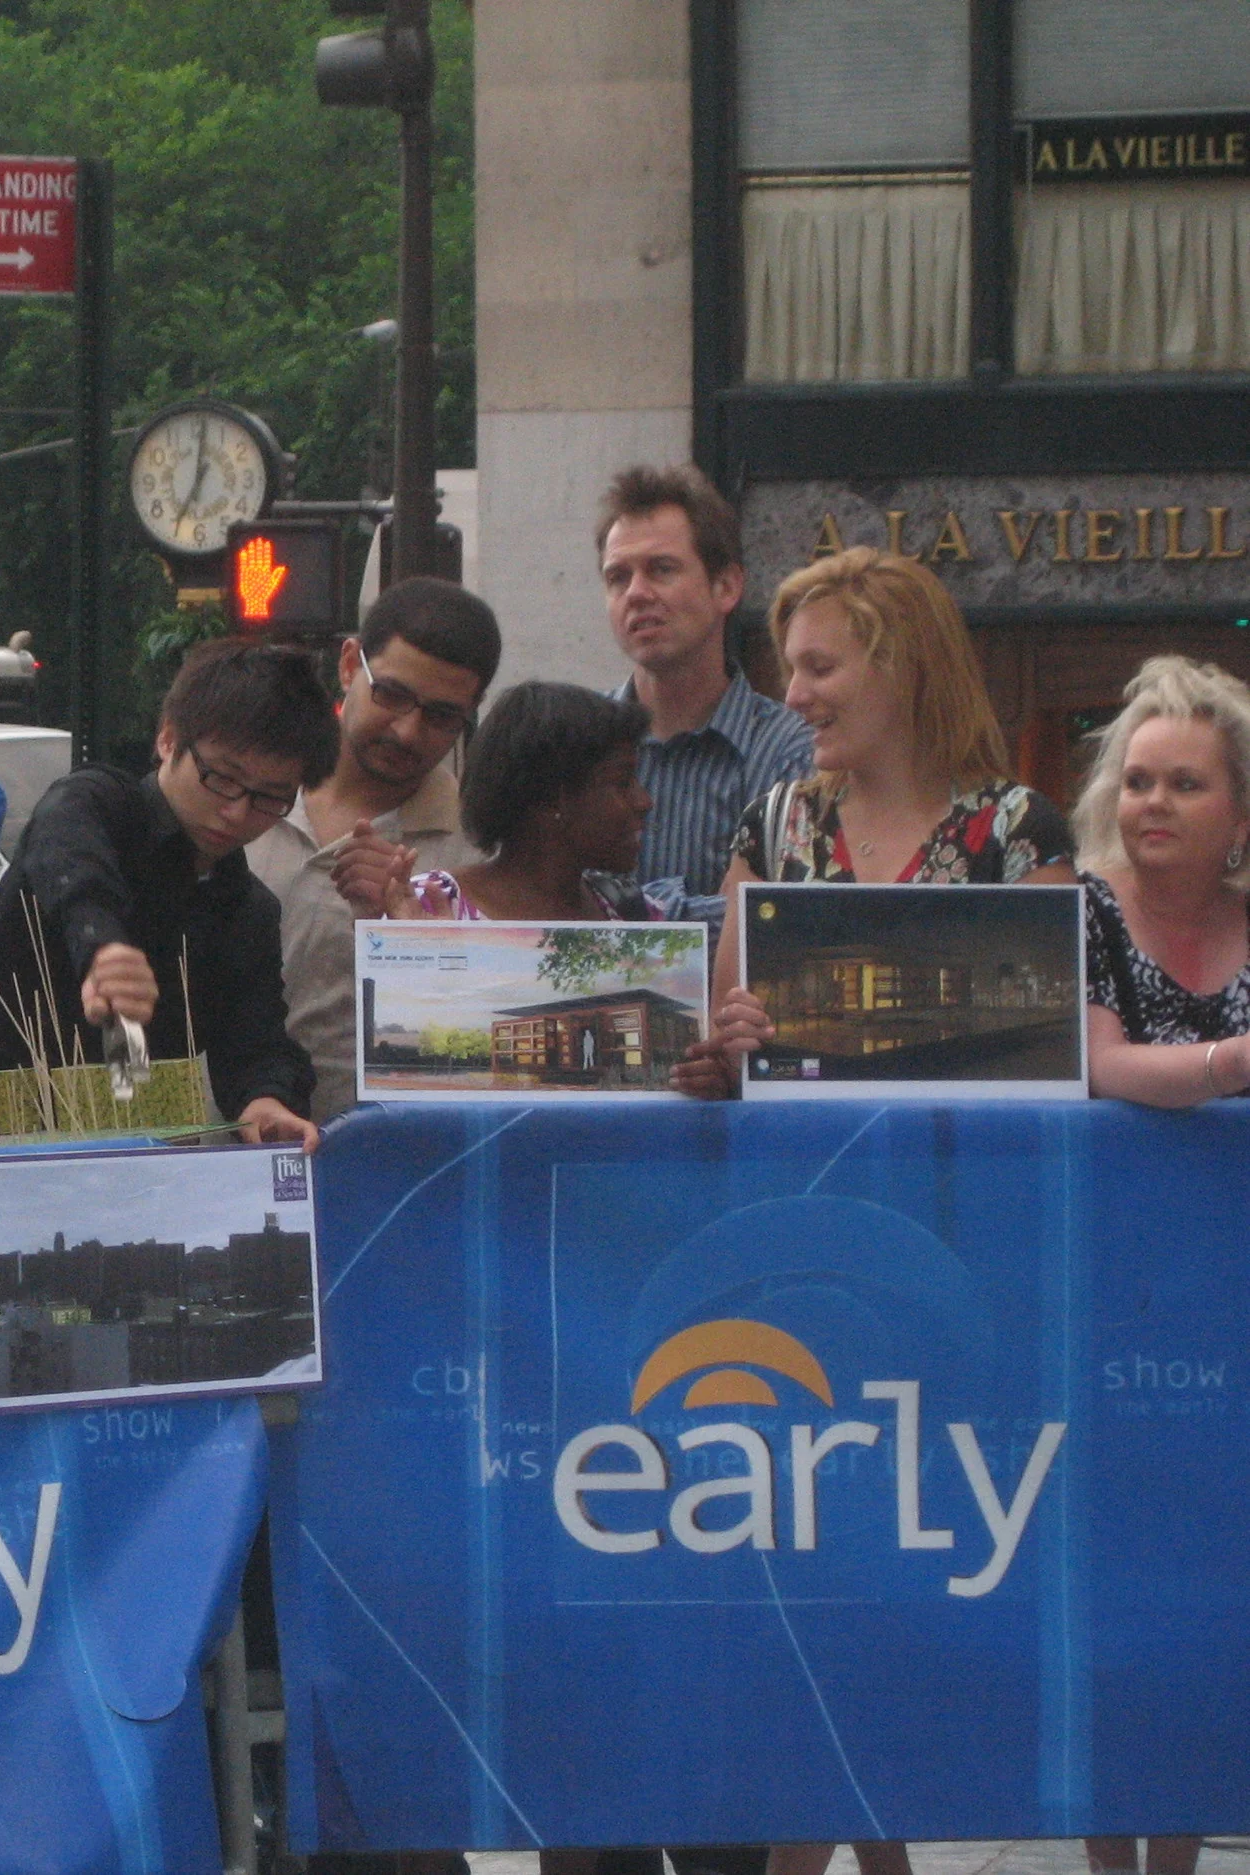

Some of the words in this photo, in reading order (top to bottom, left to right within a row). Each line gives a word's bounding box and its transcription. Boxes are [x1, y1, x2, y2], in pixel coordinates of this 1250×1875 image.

[1036, 140, 1058, 171] A
[1066, 138, 1109, 171] LA
[1113, 132, 1247, 169] VIEILLE
[151, 498, 164, 519] 8
[810, 510, 848, 562] A
[886, 508, 975, 562] LA
[276, 1154, 304, 1182] the
[1103, 1353, 1226, 1390] show
[82, 1407, 173, 1445] show
[553, 1379, 1068, 1598] early
